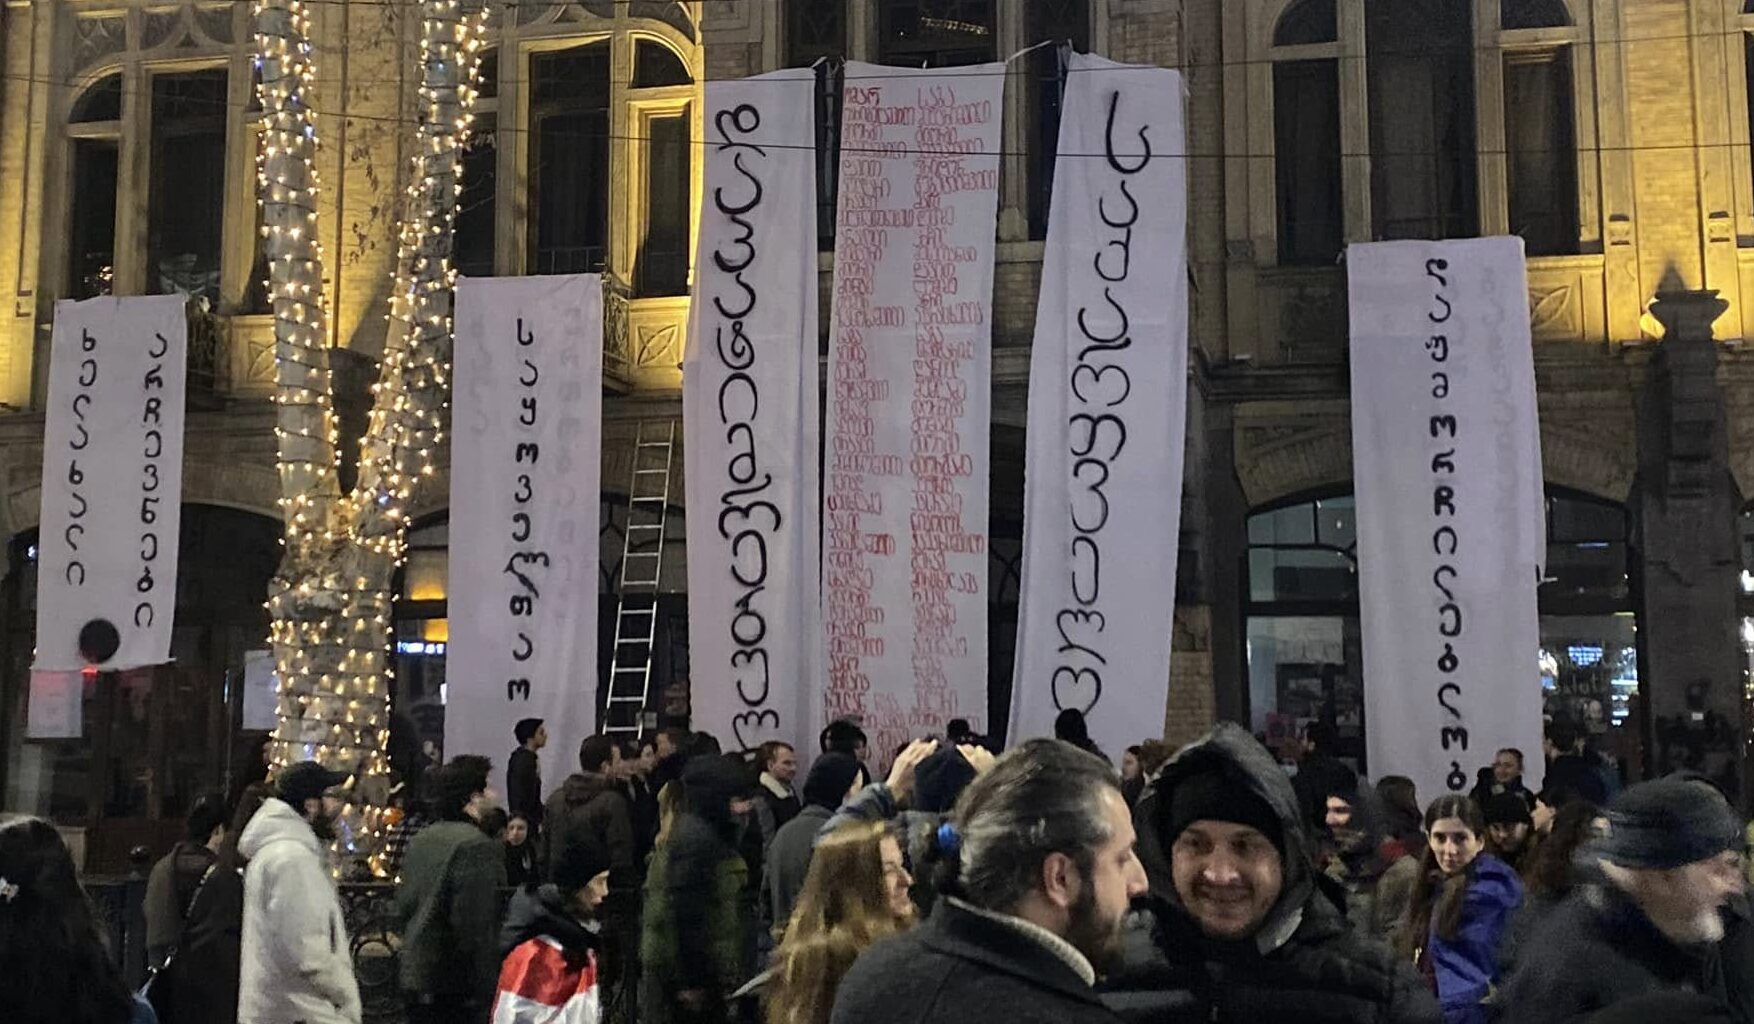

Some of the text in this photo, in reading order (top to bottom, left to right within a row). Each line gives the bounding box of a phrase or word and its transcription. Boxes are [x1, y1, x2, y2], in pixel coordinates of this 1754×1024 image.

[64, 327, 97, 586] ხელახალი
[134, 332, 168, 628] არჩევნები
[503, 317, 550, 701] საყოველთაო
[1425, 257, 1469, 791] დაუმორჩილებლობ
